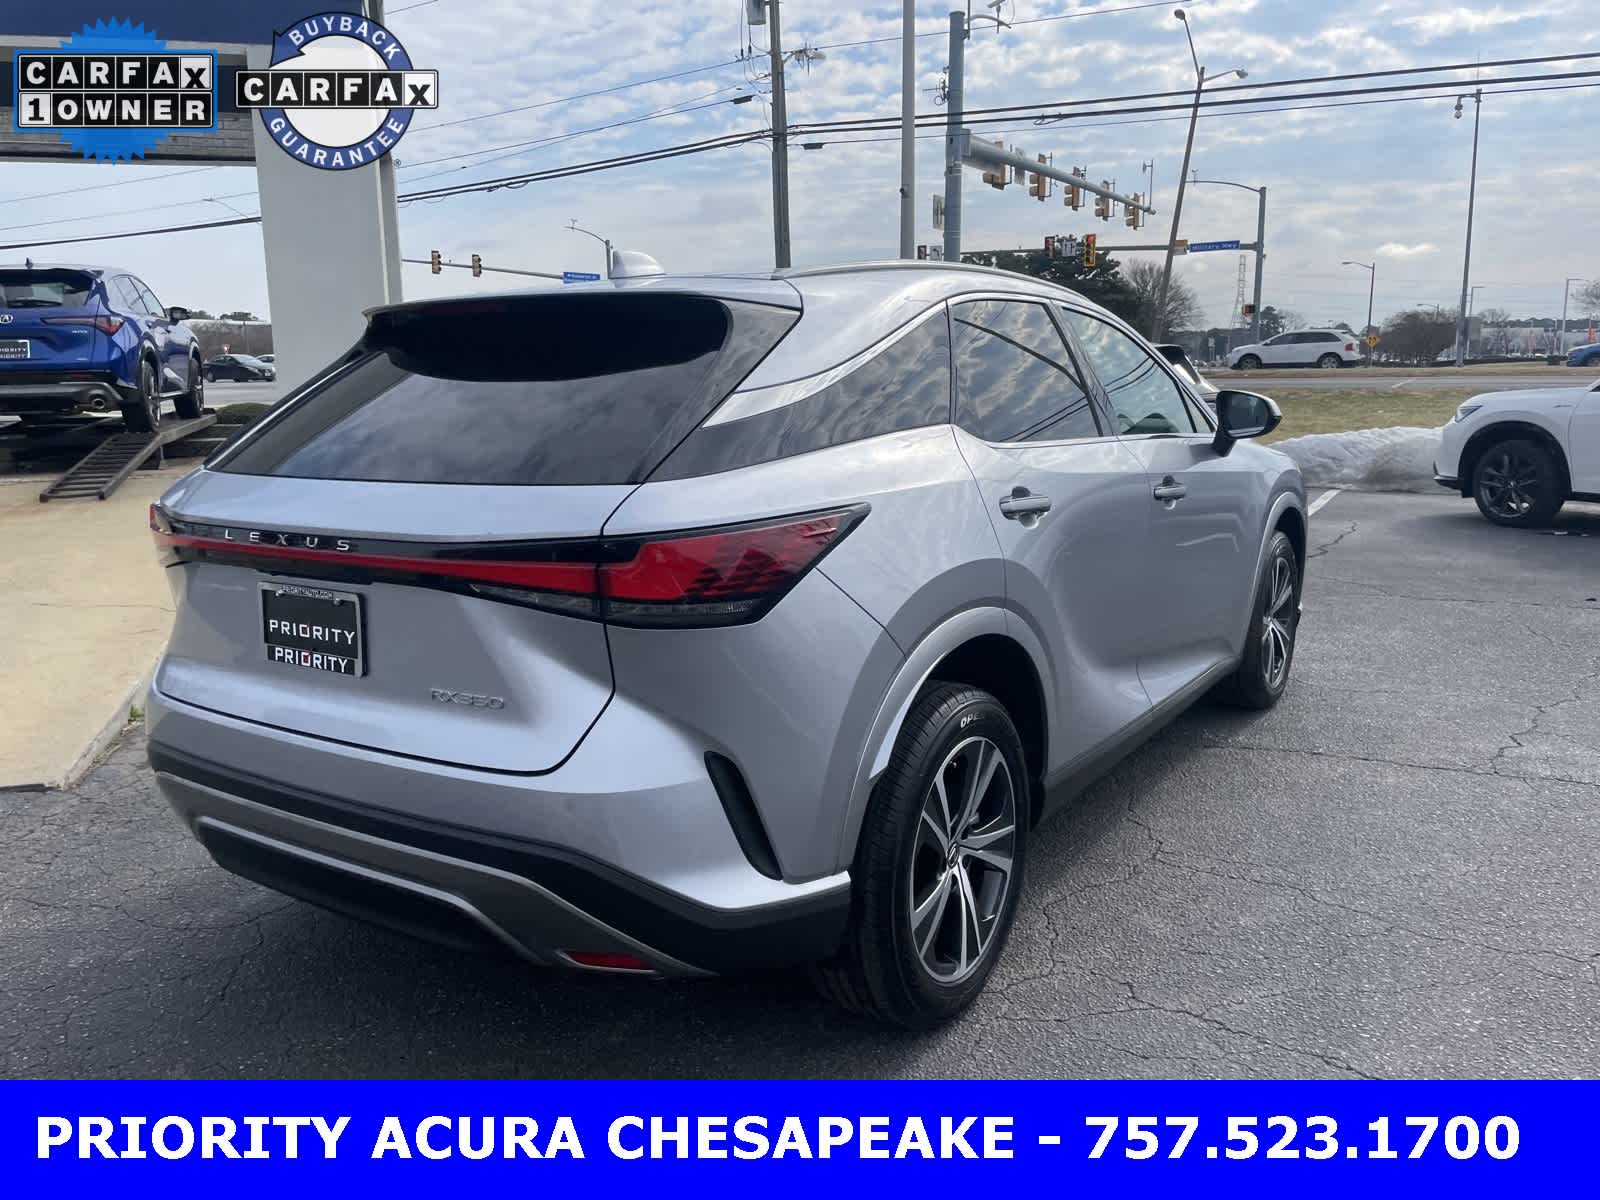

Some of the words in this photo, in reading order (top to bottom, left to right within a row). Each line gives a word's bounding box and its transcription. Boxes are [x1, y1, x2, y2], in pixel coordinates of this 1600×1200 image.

[224, 529, 350, 551] LEXUS
[269, 619, 355, 645] PRIORITY
[275, 647, 348, 673] PRIORITY
